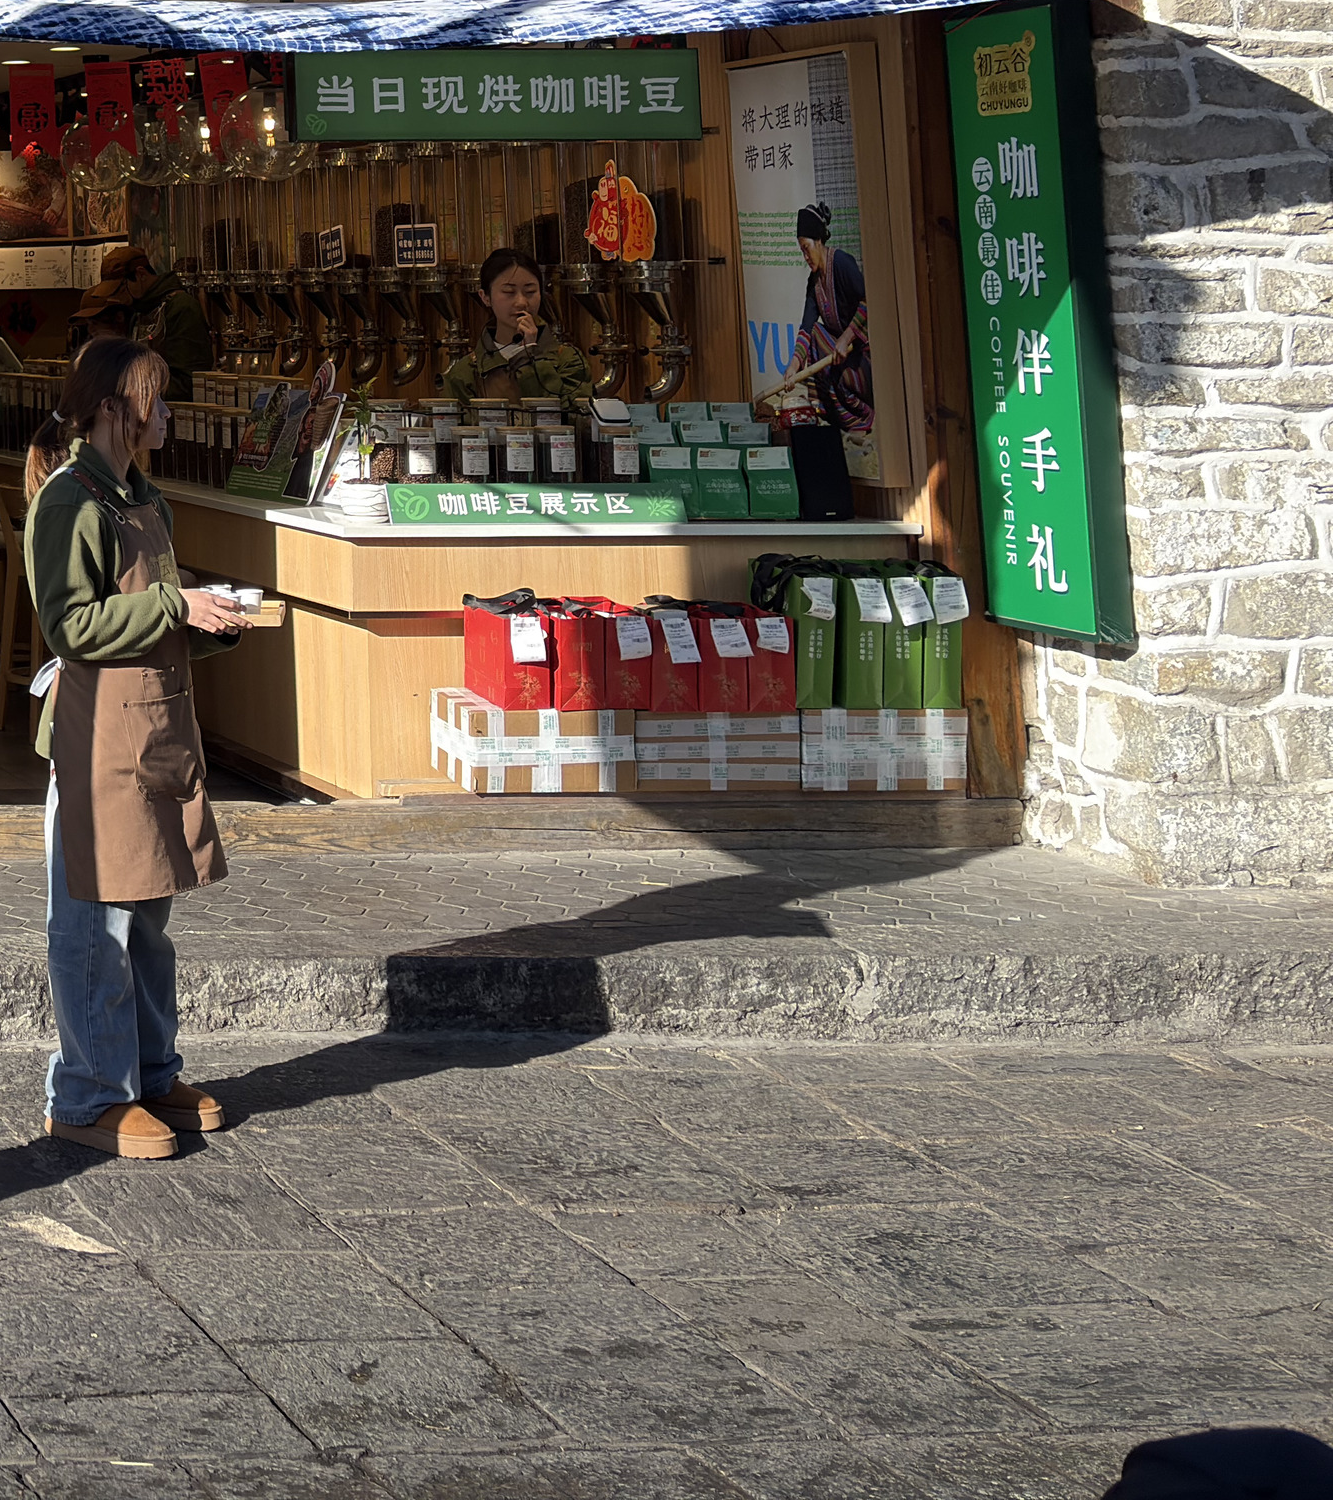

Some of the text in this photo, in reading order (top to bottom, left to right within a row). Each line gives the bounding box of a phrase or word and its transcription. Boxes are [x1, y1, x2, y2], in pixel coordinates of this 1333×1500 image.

[977, 47, 1028, 77] 初云谷
[316, 73, 685, 116] 当日现烘咖啡豆
[980, 78, 1028, 97] 云南好咖啡
[980, 97, 1029, 112] CHUYUNGU
[741, 95, 846, 134] 将大理的味道
[744, 142, 794, 172] 带回家
[973, 160, 1002, 302] 云南最佳
[997, 136, 1069, 595] 咖啡伴手礼
[989, 316, 1018, 566] COFFEE SOUVENIR
[436, 491, 634, 516] 咖啡豆展示区
